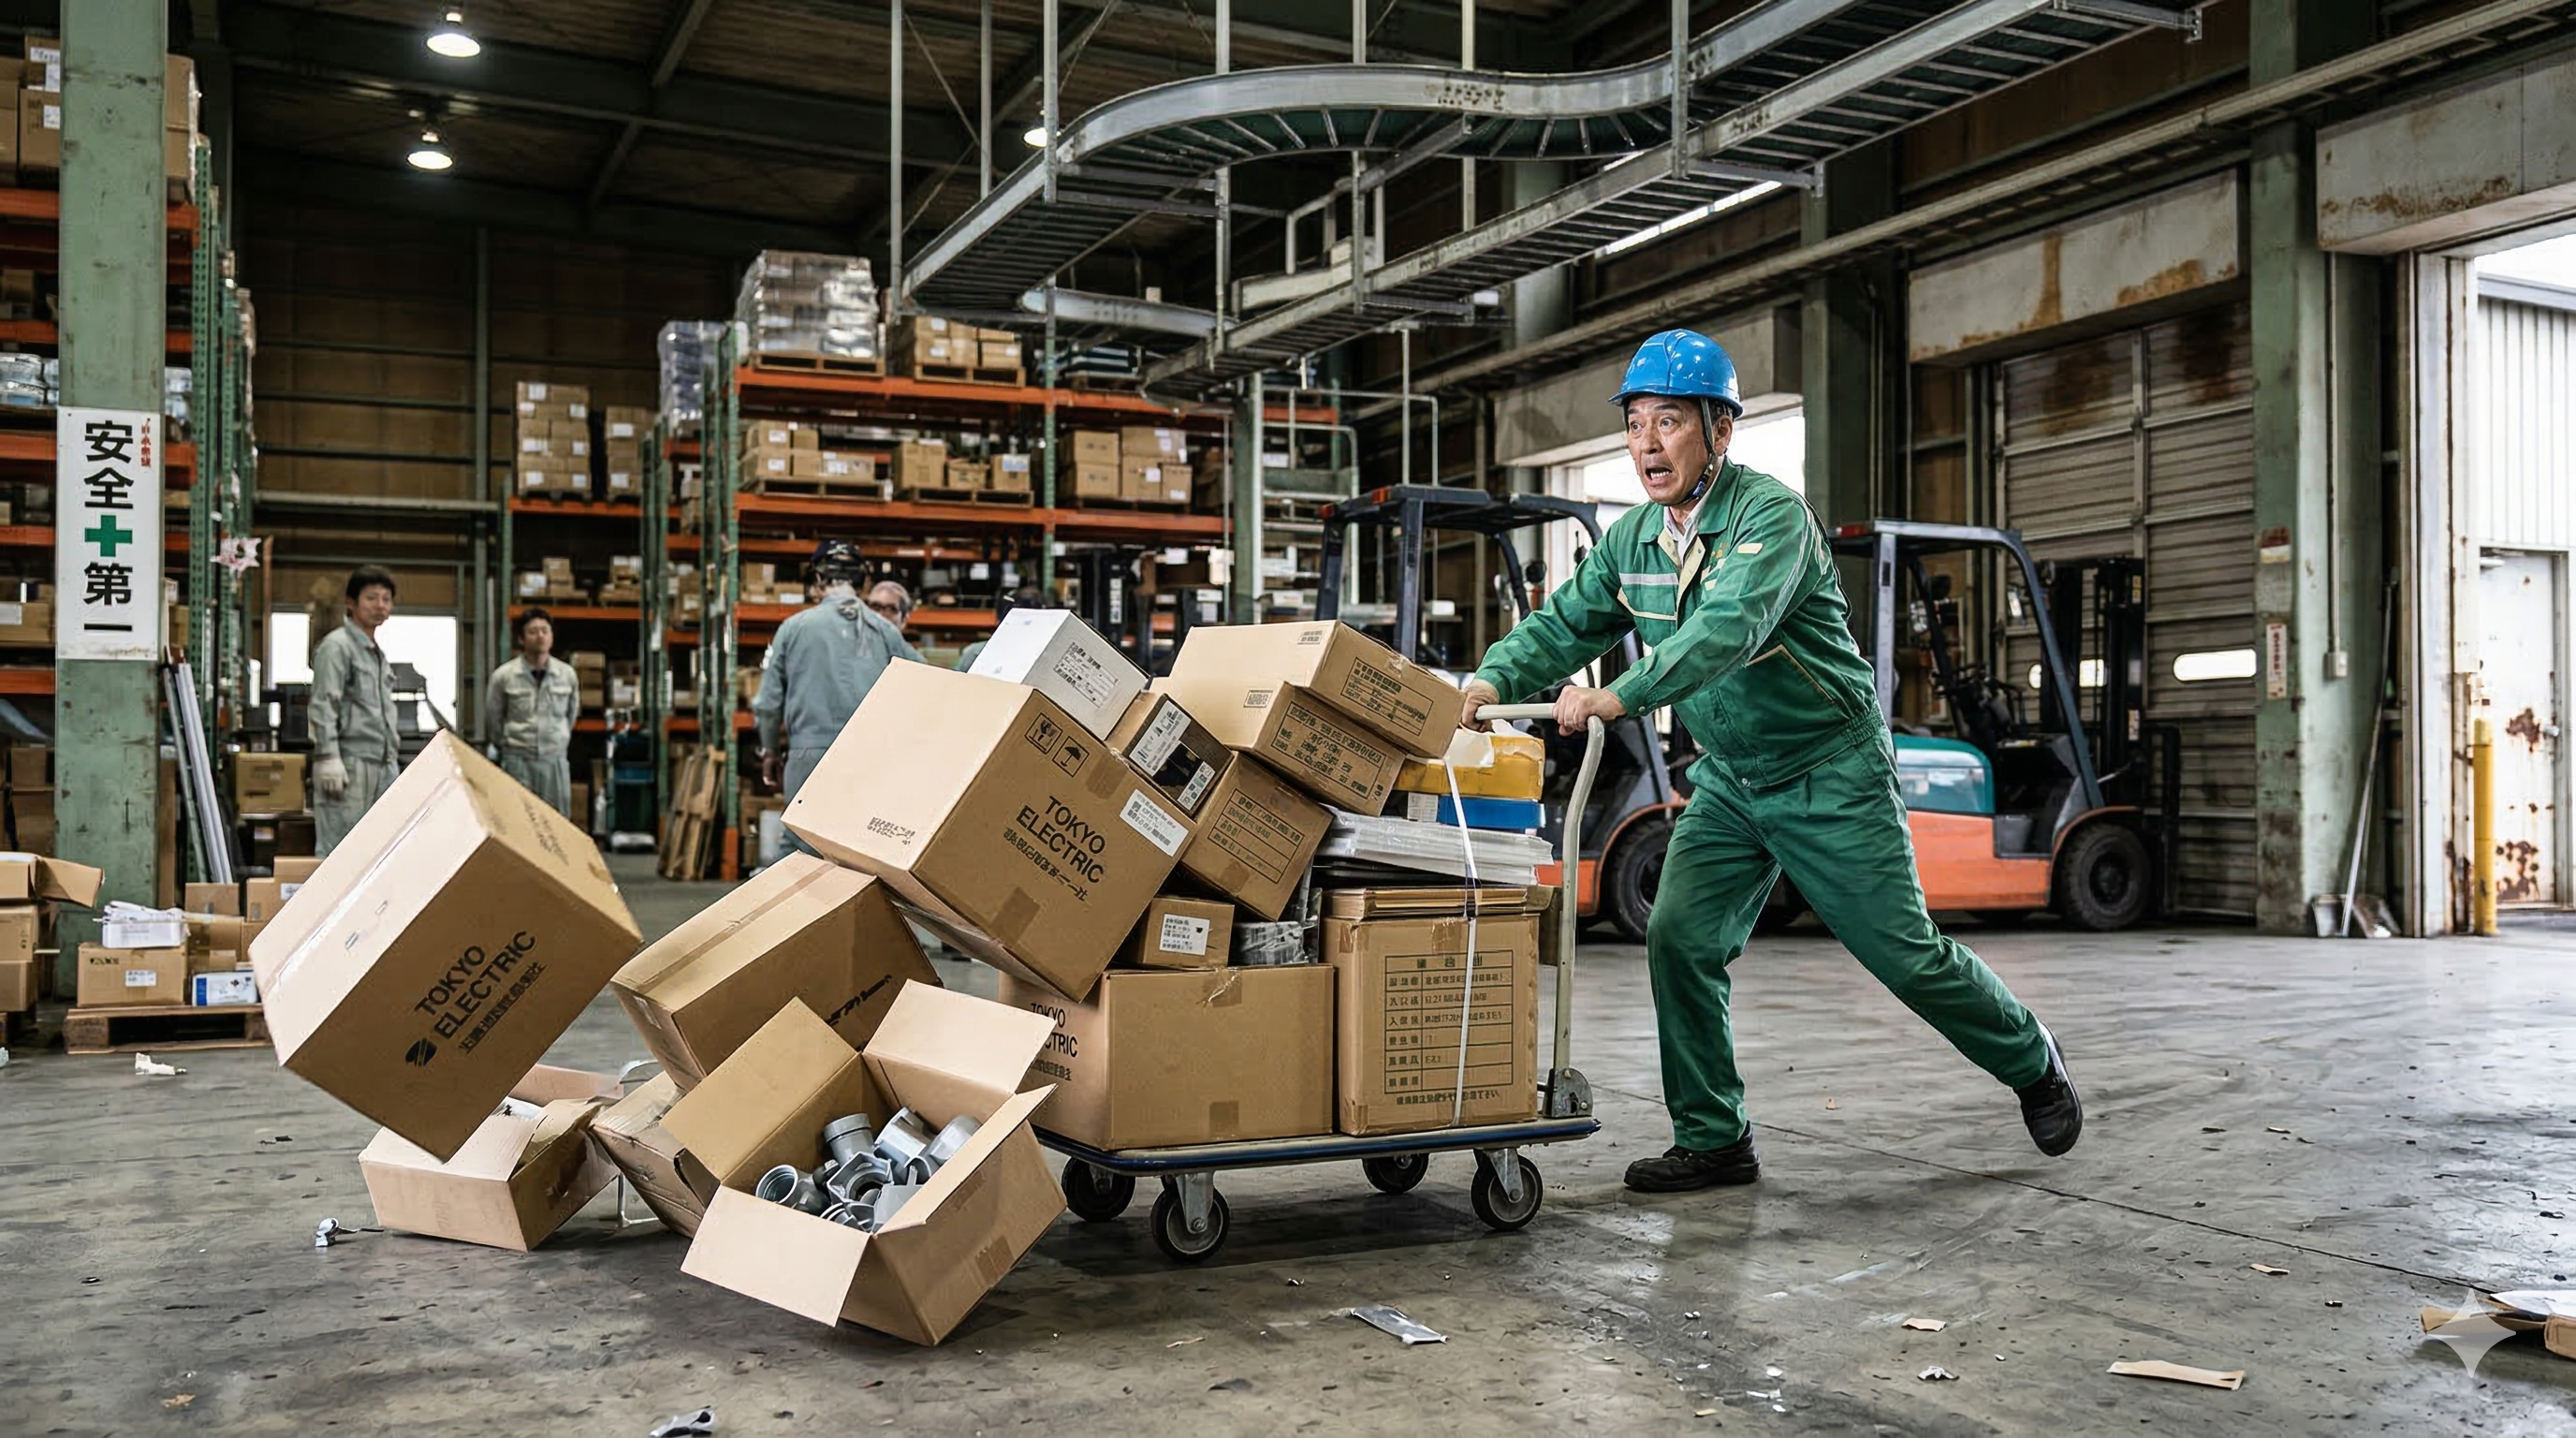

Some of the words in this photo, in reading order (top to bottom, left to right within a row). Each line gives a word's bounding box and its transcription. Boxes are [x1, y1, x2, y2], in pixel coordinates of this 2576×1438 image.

[1016, 805, 1105, 883] ELECTRIC
[1046, 795, 1105, 854] TOKYO
[414, 946, 486, 1016] TOKYO
[433, 931, 536, 1039] ELECTRIC
